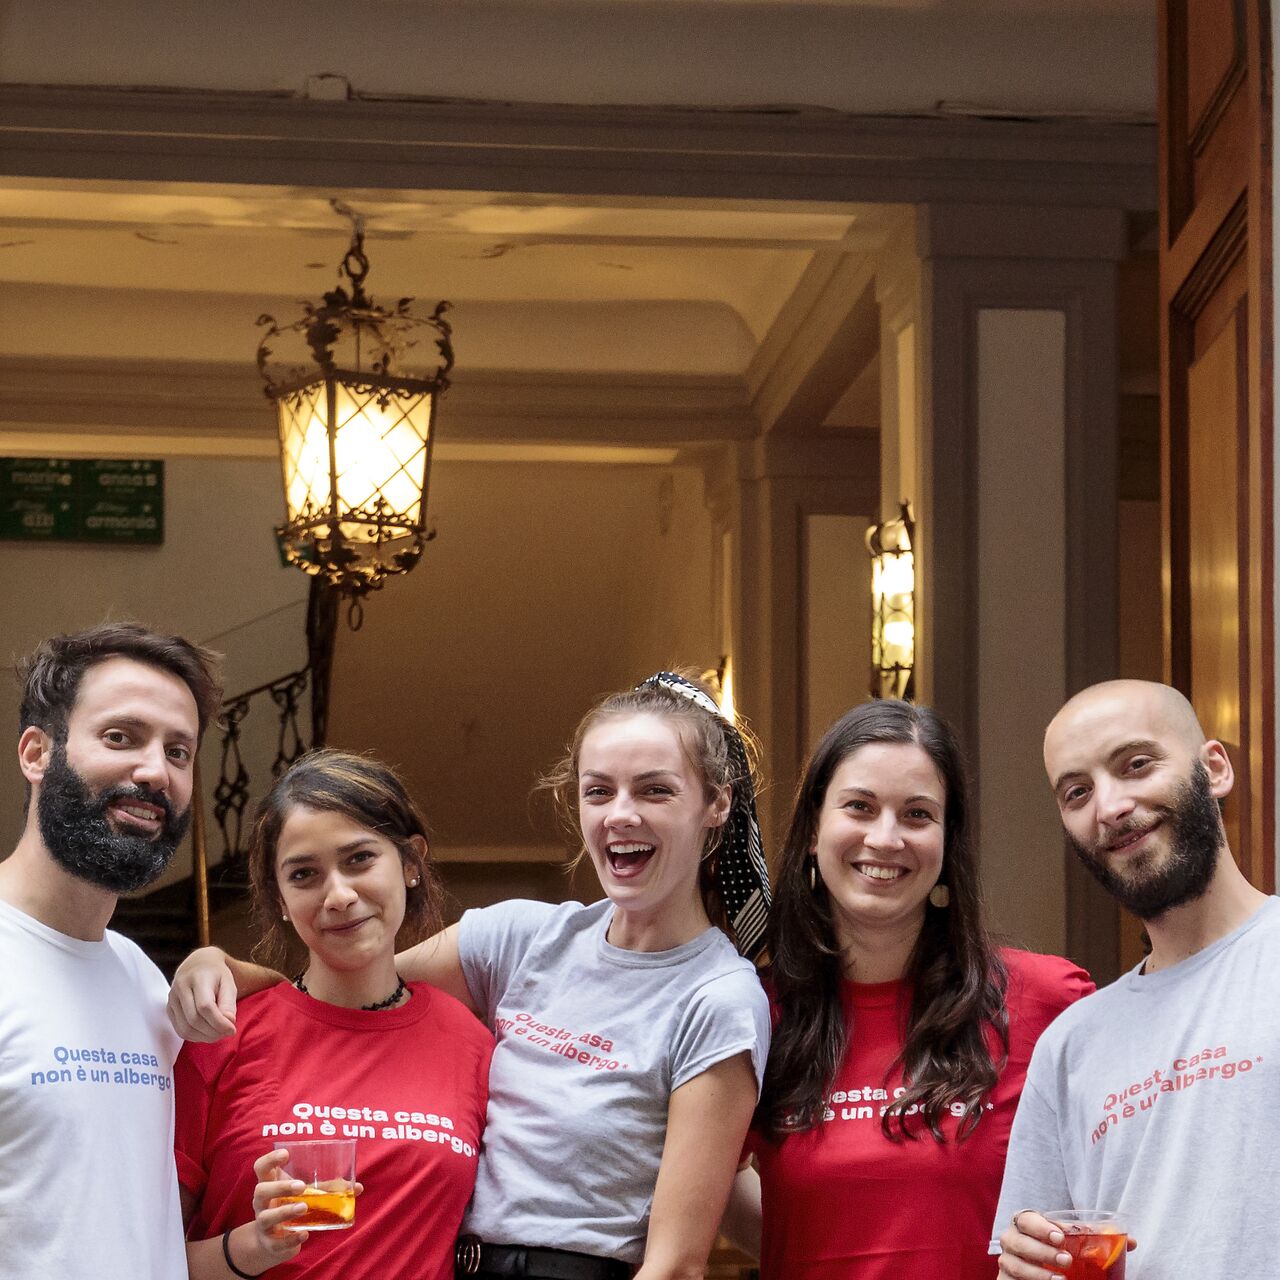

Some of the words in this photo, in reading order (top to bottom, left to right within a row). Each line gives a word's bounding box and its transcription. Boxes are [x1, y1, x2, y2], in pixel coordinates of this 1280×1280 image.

[515, 1012, 572, 1041] Questa
[572, 1032, 614, 1052] asa
[527, 1034, 551, 1047] un
[53, 1046, 117, 1065] Questa
[120, 1051, 158, 1067] casa
[31, 1068, 71, 1085] non
[76, 1065, 87, 1082] è
[91, 1069, 110, 1083] un
[1103, 1069, 1167, 1111] Quest
[1173, 1046, 1227, 1071] casa
[829, 1086, 888, 1104] esta
[292, 1102, 390, 1123] Questa
[394, 1109, 455, 1131] casa
[841, 1105, 874, 1121] un
[262, 1121, 314, 1137] non
[320, 1119, 337, 1136] è
[342, 1123, 376, 1139] un
[1091, 1112, 1118, 1145] non
